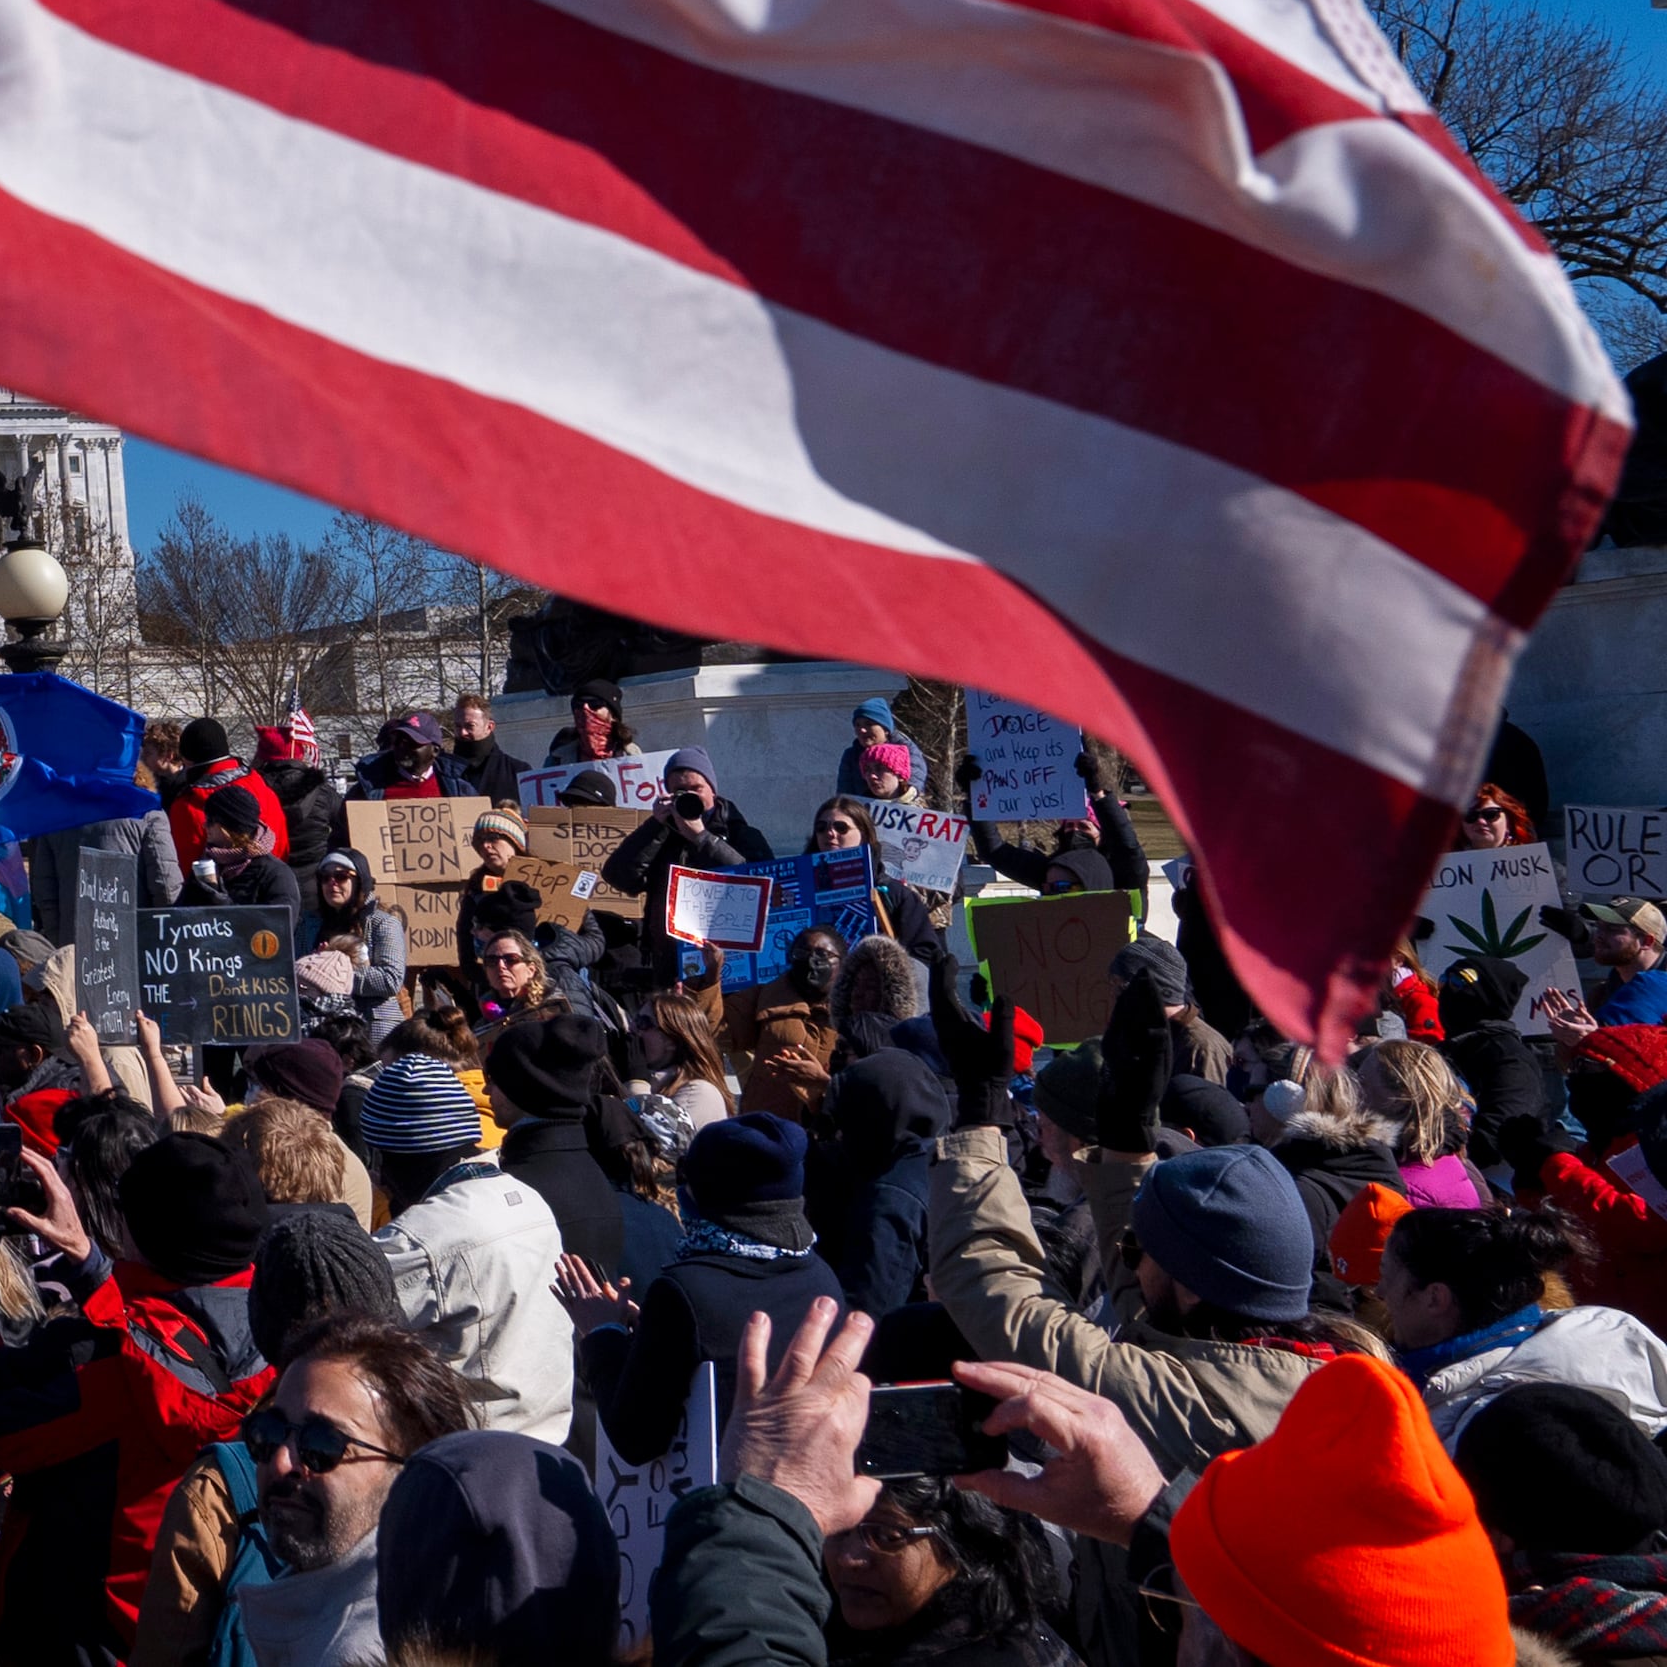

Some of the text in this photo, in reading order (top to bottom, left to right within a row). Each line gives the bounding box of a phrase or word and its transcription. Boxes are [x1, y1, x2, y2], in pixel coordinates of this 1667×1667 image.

[986, 746, 1006, 761] and
[1046, 739, 1064, 757] its
[984, 766, 1058, 794] PAWS OFF
[388, 802, 451, 823] STOP
[999, 796, 1018, 811] our
[379, 821, 456, 850] FELON
[553, 823, 626, 840] SEND
[1568, 808, 1662, 855] RULE
[382, 846, 460, 875] ELON
[1431, 855, 1549, 889] LON MUSK
[1583, 854, 1662, 893] OR
[518, 864, 569, 894] Stop
[682, 878, 757, 901] POWER TO
[681, 900, 715, 913] THE
[153, 914, 233, 945] Tyrants
[698, 914, 754, 928] PEOPLE
[409, 927, 458, 953] KIDDIN
[1014, 916, 1091, 969] NO
[145, 948, 243, 978] NO Kings
[143, 984, 171, 1004] THE
[209, 974, 289, 998] Don't KISS
[212, 1001, 291, 1037] RINGS
